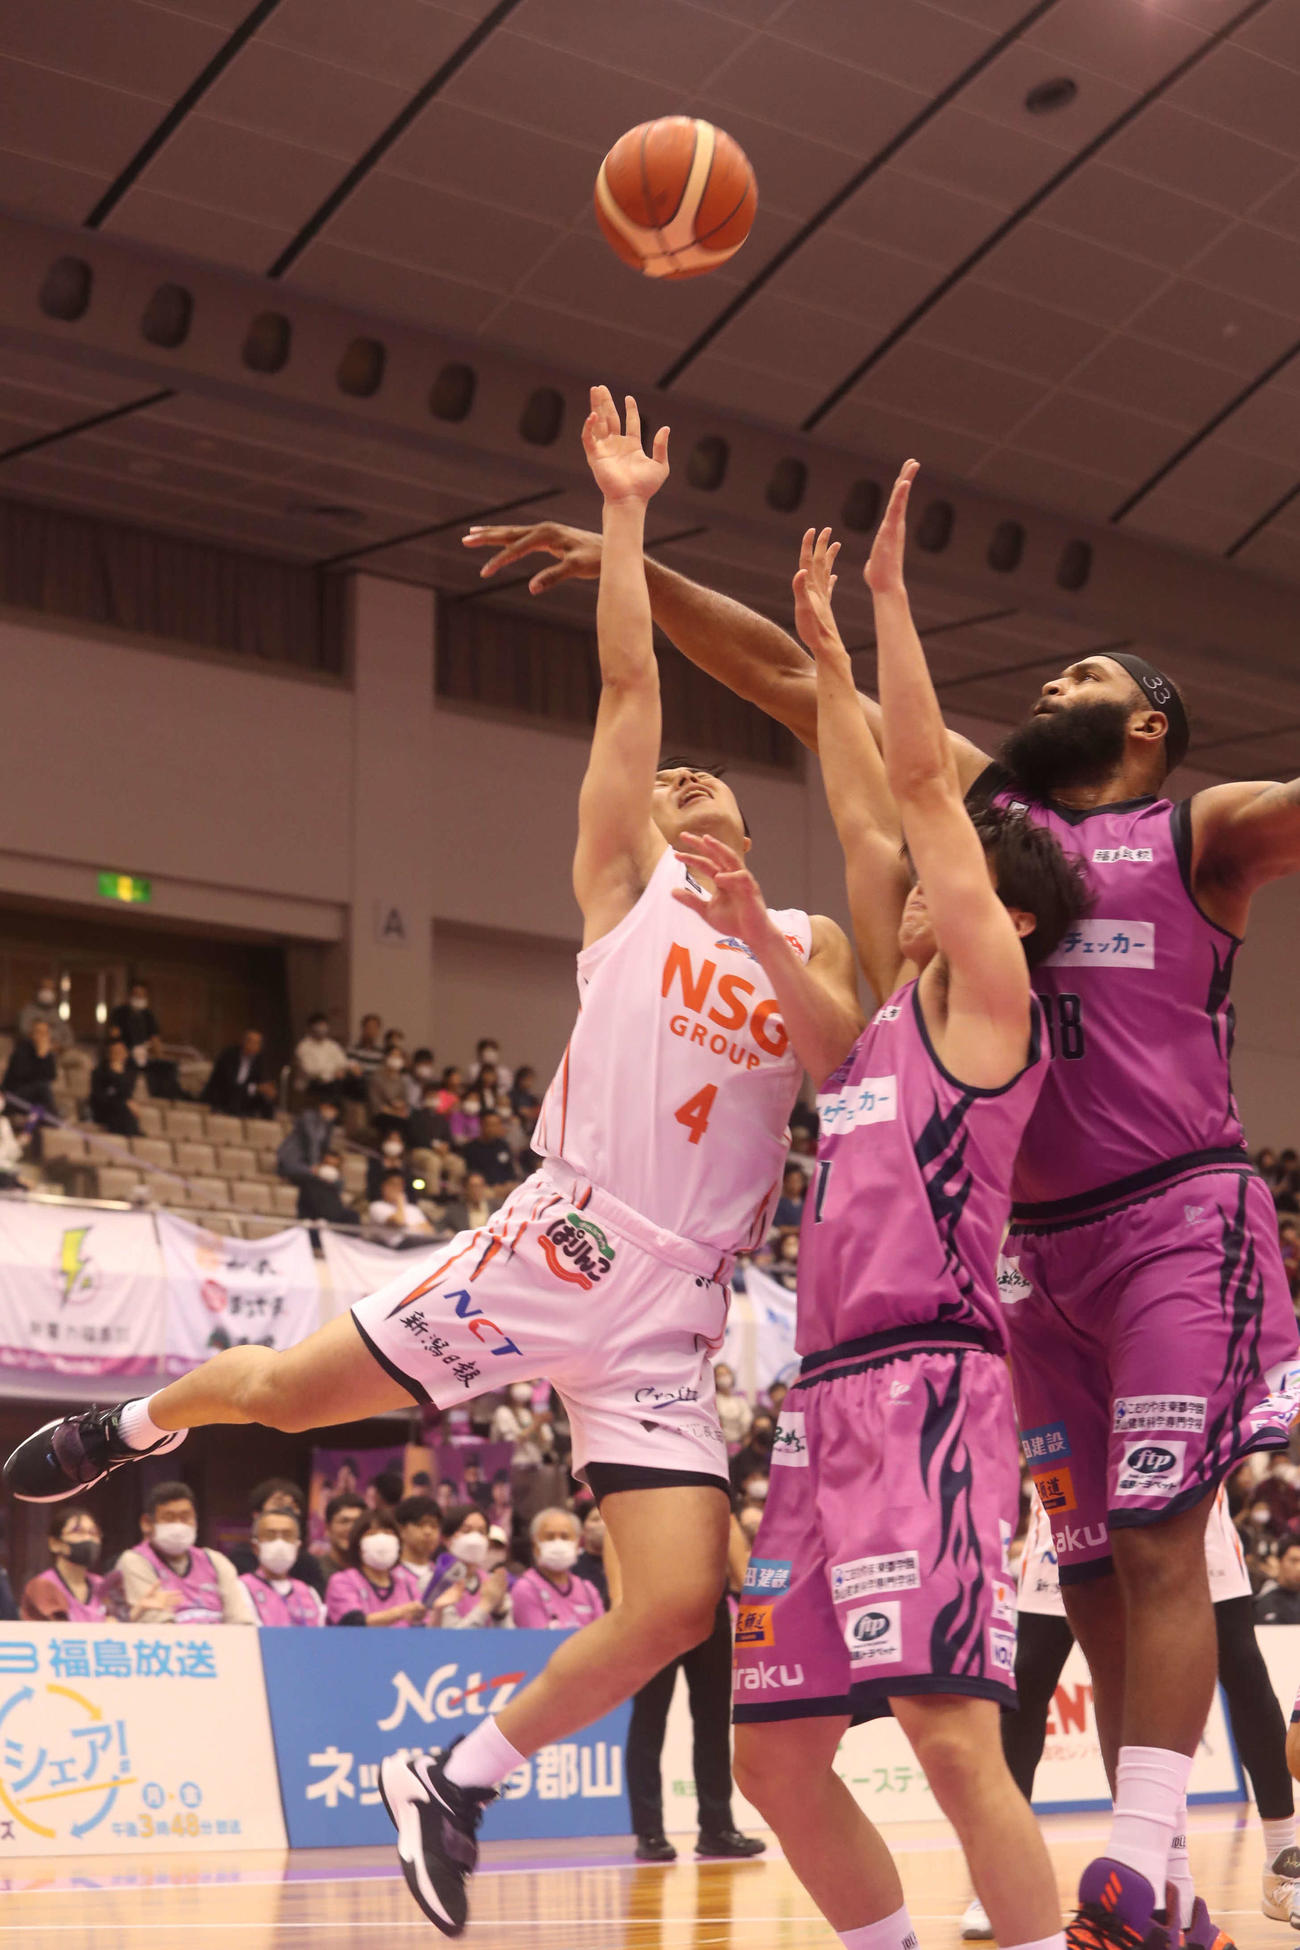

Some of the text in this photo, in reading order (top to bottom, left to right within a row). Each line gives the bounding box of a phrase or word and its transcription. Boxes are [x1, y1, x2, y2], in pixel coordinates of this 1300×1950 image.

[1143, 676, 1171, 705] 33
[383, 907, 405, 937] A
[661, 941, 789, 1058] NSG
[669, 1015, 761, 1071] GROUP
[674, 1083, 718, 1145] 4
[399, 1311, 481, 1388] 新潟日報
[443, 1289, 524, 1357] NCT
